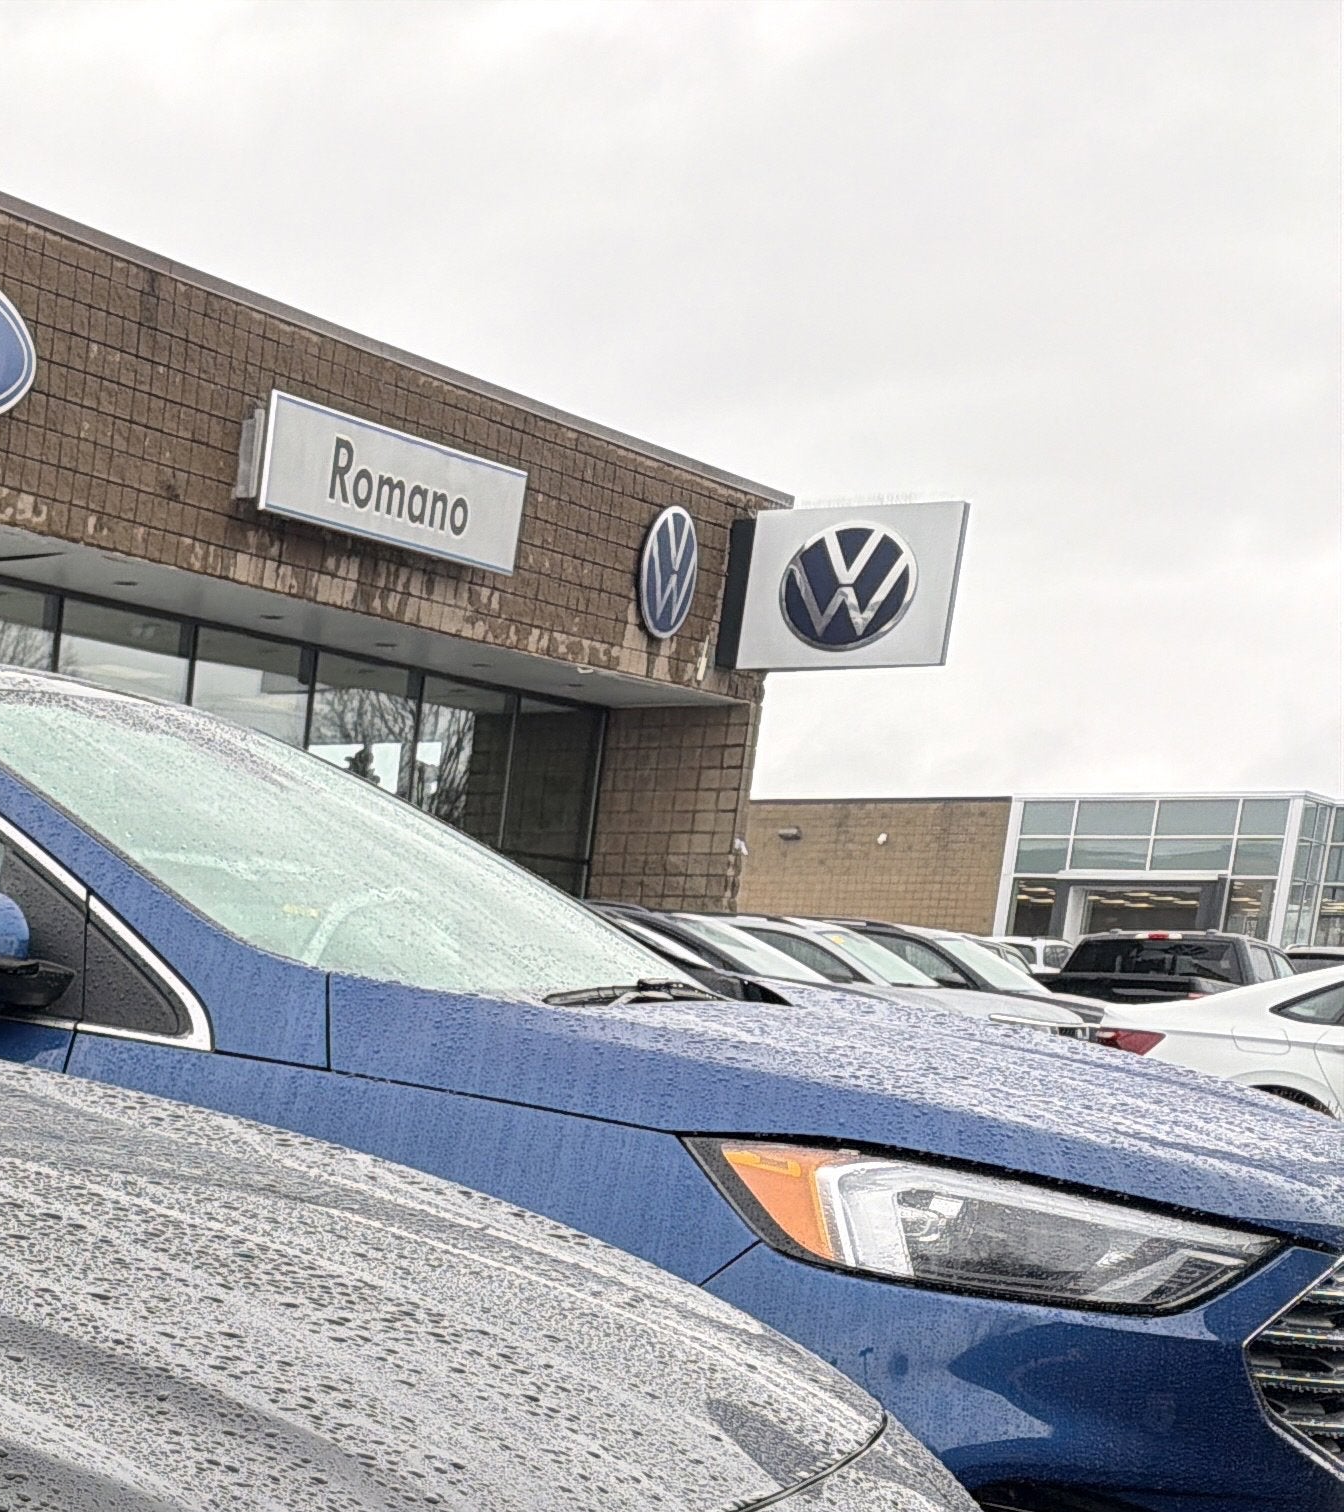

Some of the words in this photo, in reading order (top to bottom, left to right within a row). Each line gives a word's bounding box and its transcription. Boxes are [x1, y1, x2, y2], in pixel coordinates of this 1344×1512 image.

[328, 435, 469, 537] Romano
[644, 508, 697, 634] VW
[783, 525, 915, 643] VW
